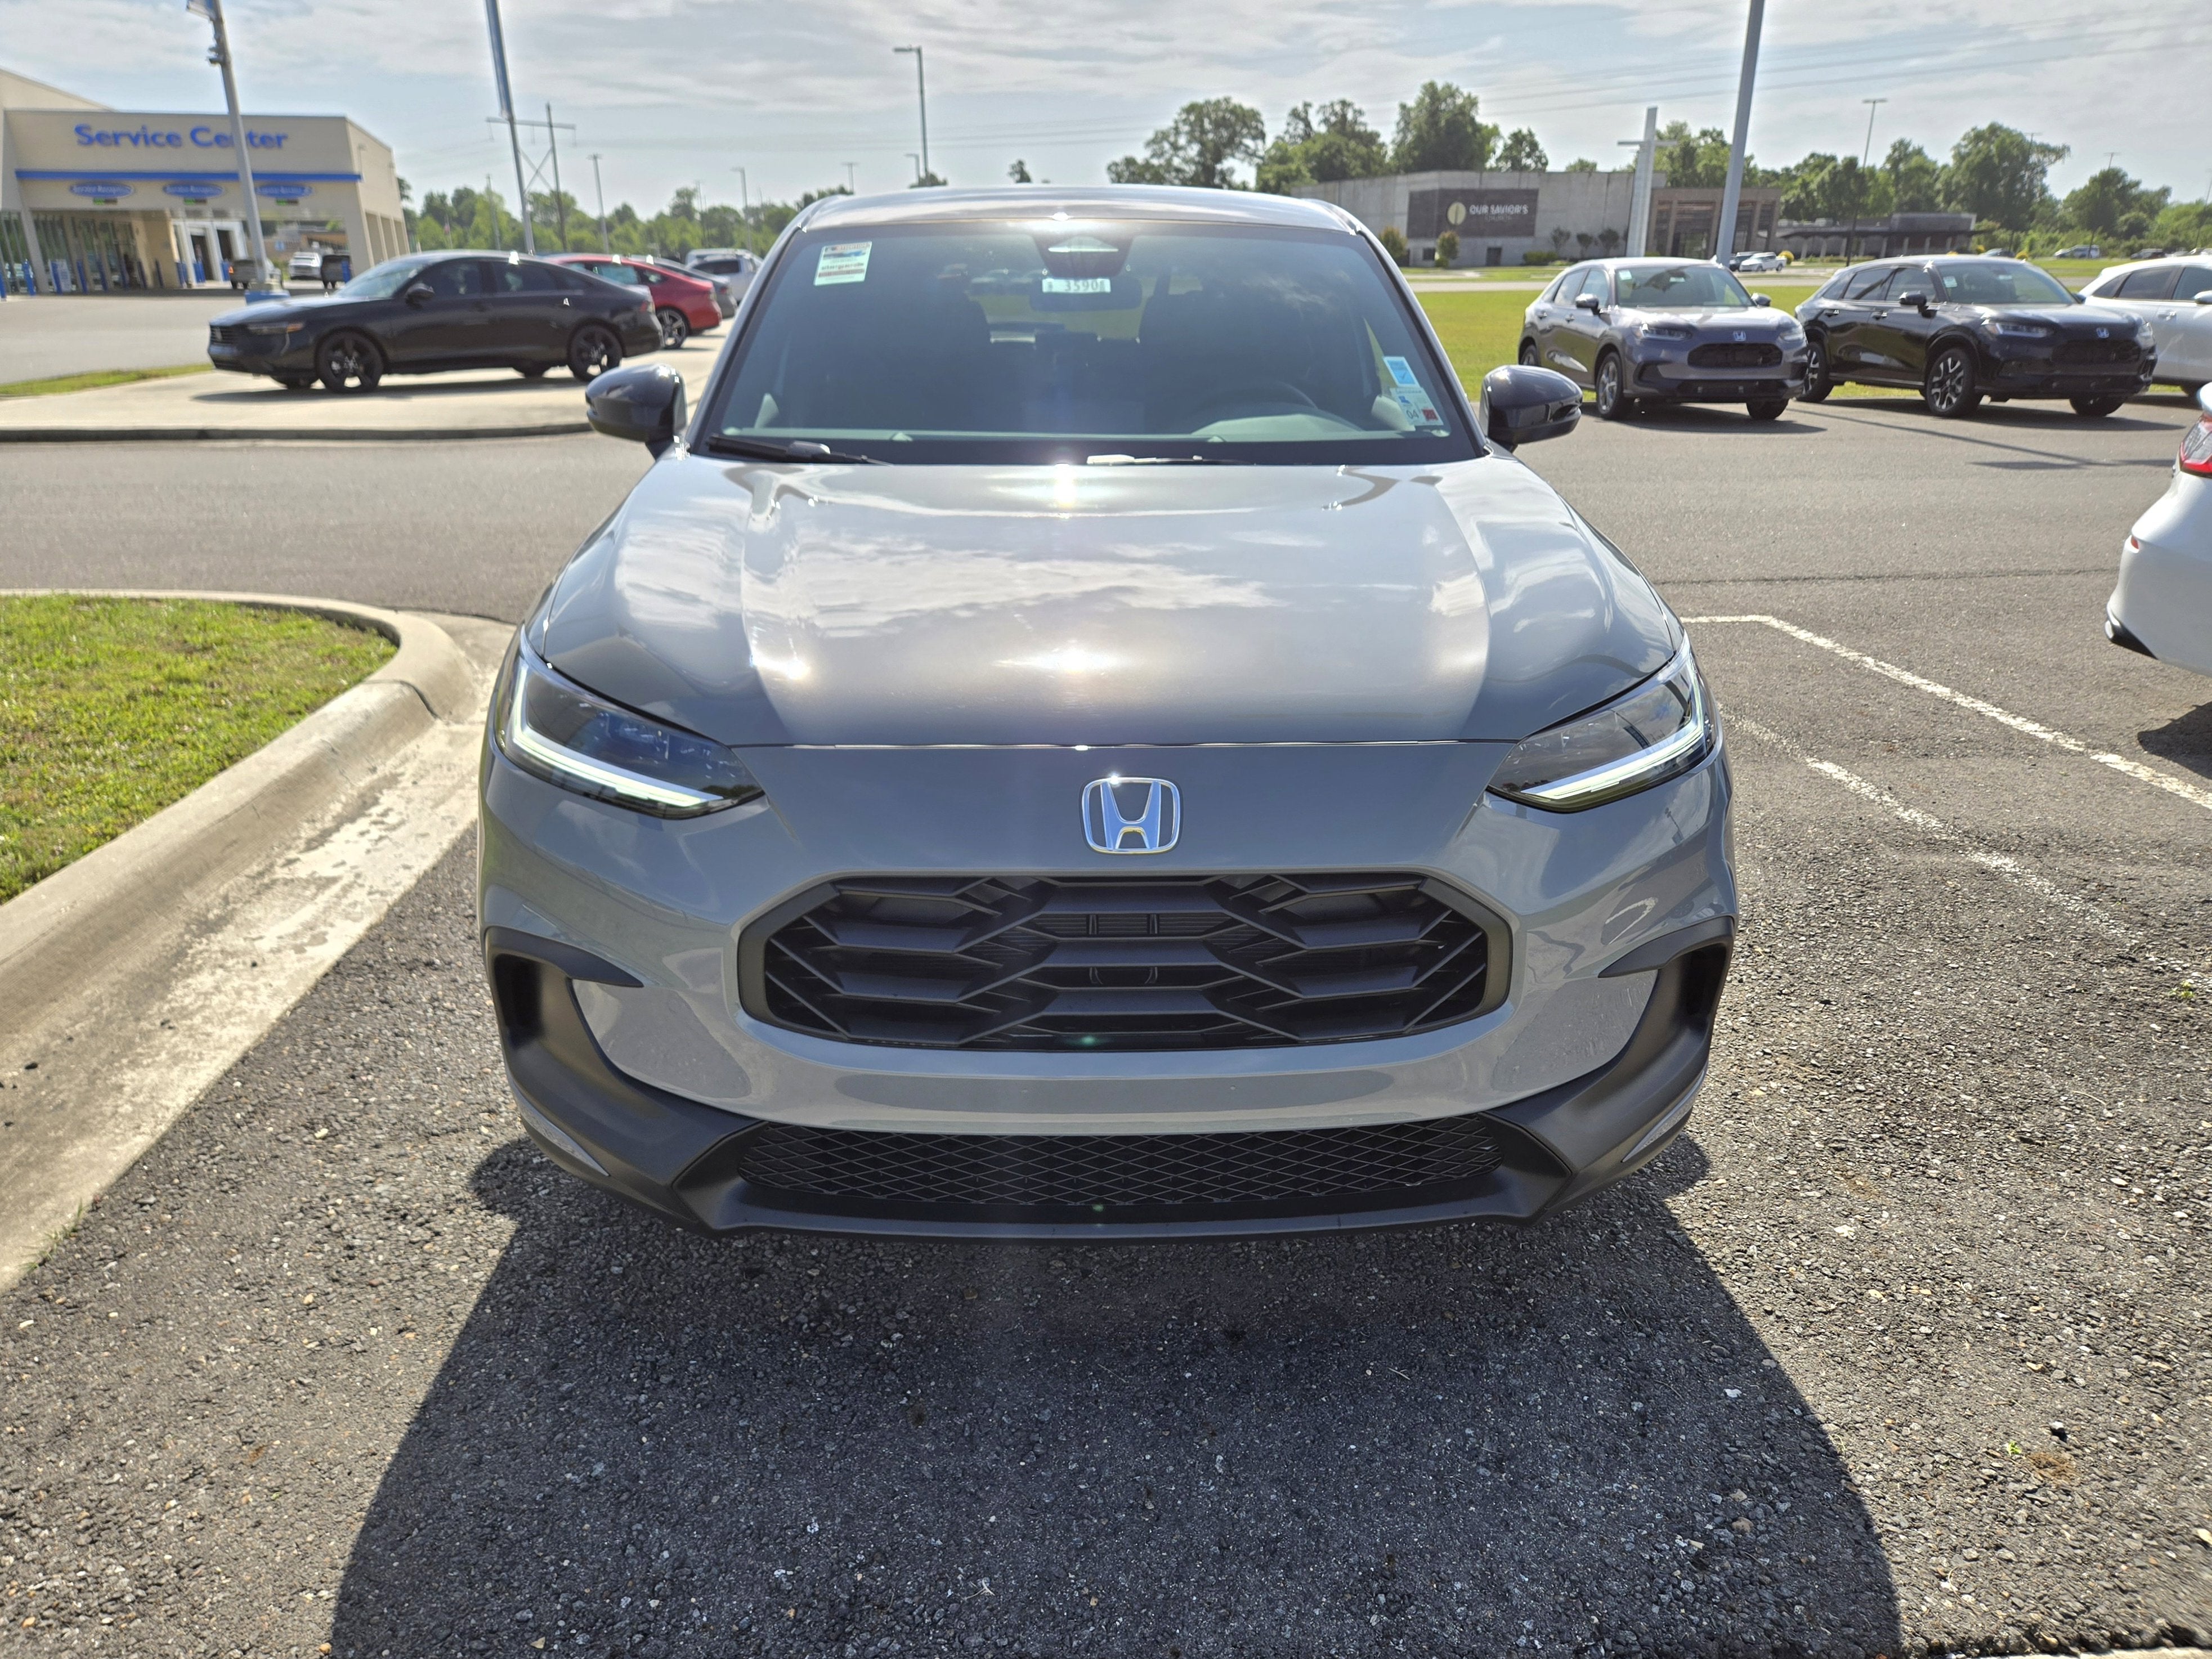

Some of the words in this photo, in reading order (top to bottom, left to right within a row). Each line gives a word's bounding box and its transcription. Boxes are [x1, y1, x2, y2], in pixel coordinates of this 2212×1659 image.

[74, 123, 182, 147] Service
[1470, 205, 1489, 214] OUR
[1407, 410, 1419, 419] 04
